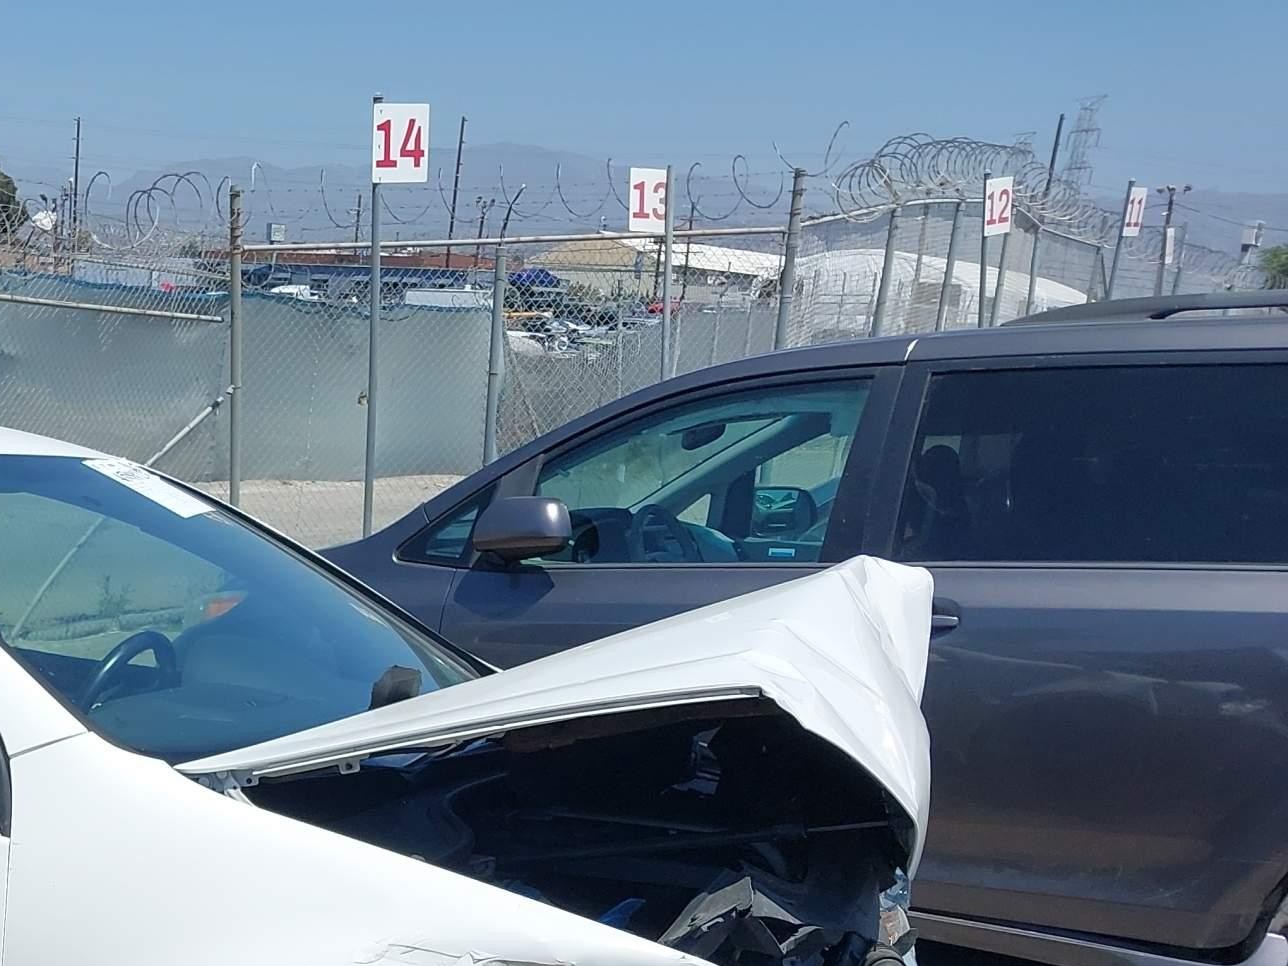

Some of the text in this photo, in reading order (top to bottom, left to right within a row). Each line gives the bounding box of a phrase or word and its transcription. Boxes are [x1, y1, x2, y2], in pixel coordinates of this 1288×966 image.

[376, 119, 424, 168] 14
[633, 181, 666, 220] 13
[986, 188, 1010, 226] 12
[1125, 197, 1144, 227] 11
